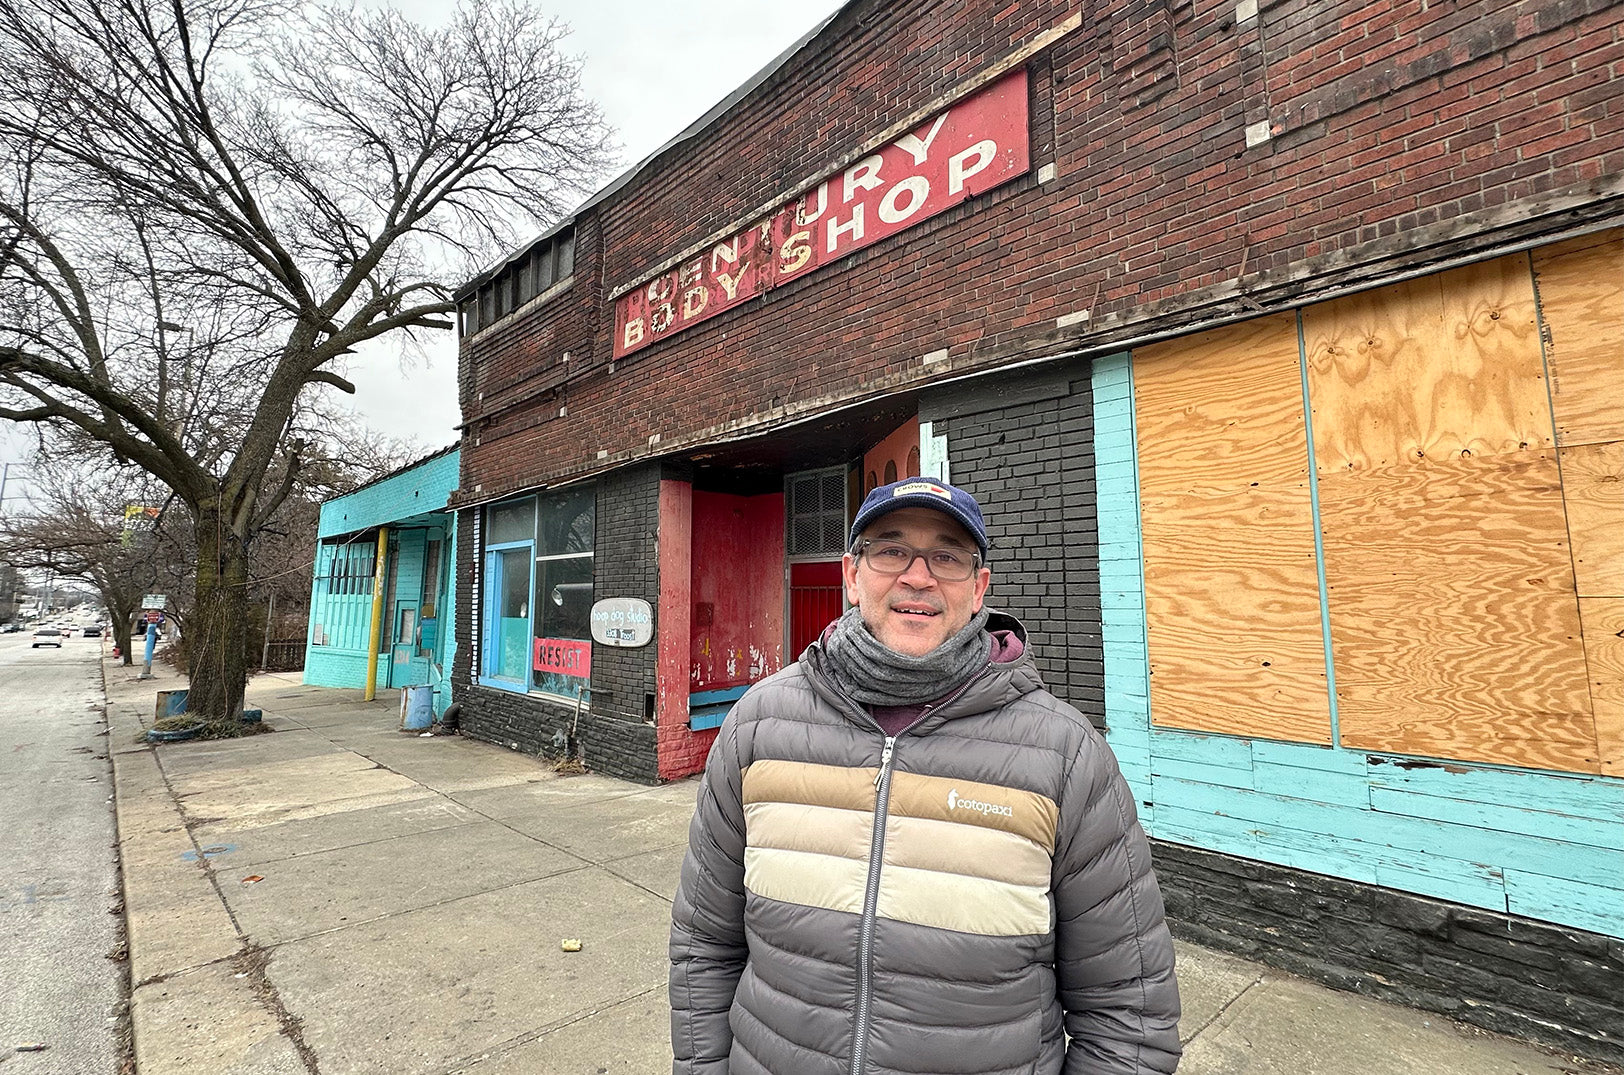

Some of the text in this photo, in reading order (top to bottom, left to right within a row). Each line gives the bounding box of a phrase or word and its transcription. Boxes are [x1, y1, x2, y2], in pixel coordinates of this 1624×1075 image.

[624, 139, 997, 349] BODY SHOP
[610, 606, 624, 627] dog
[627, 604, 648, 624] studio
[539, 645, 582, 670] RESIST
[957, 798, 1013, 817] cotopaxi
